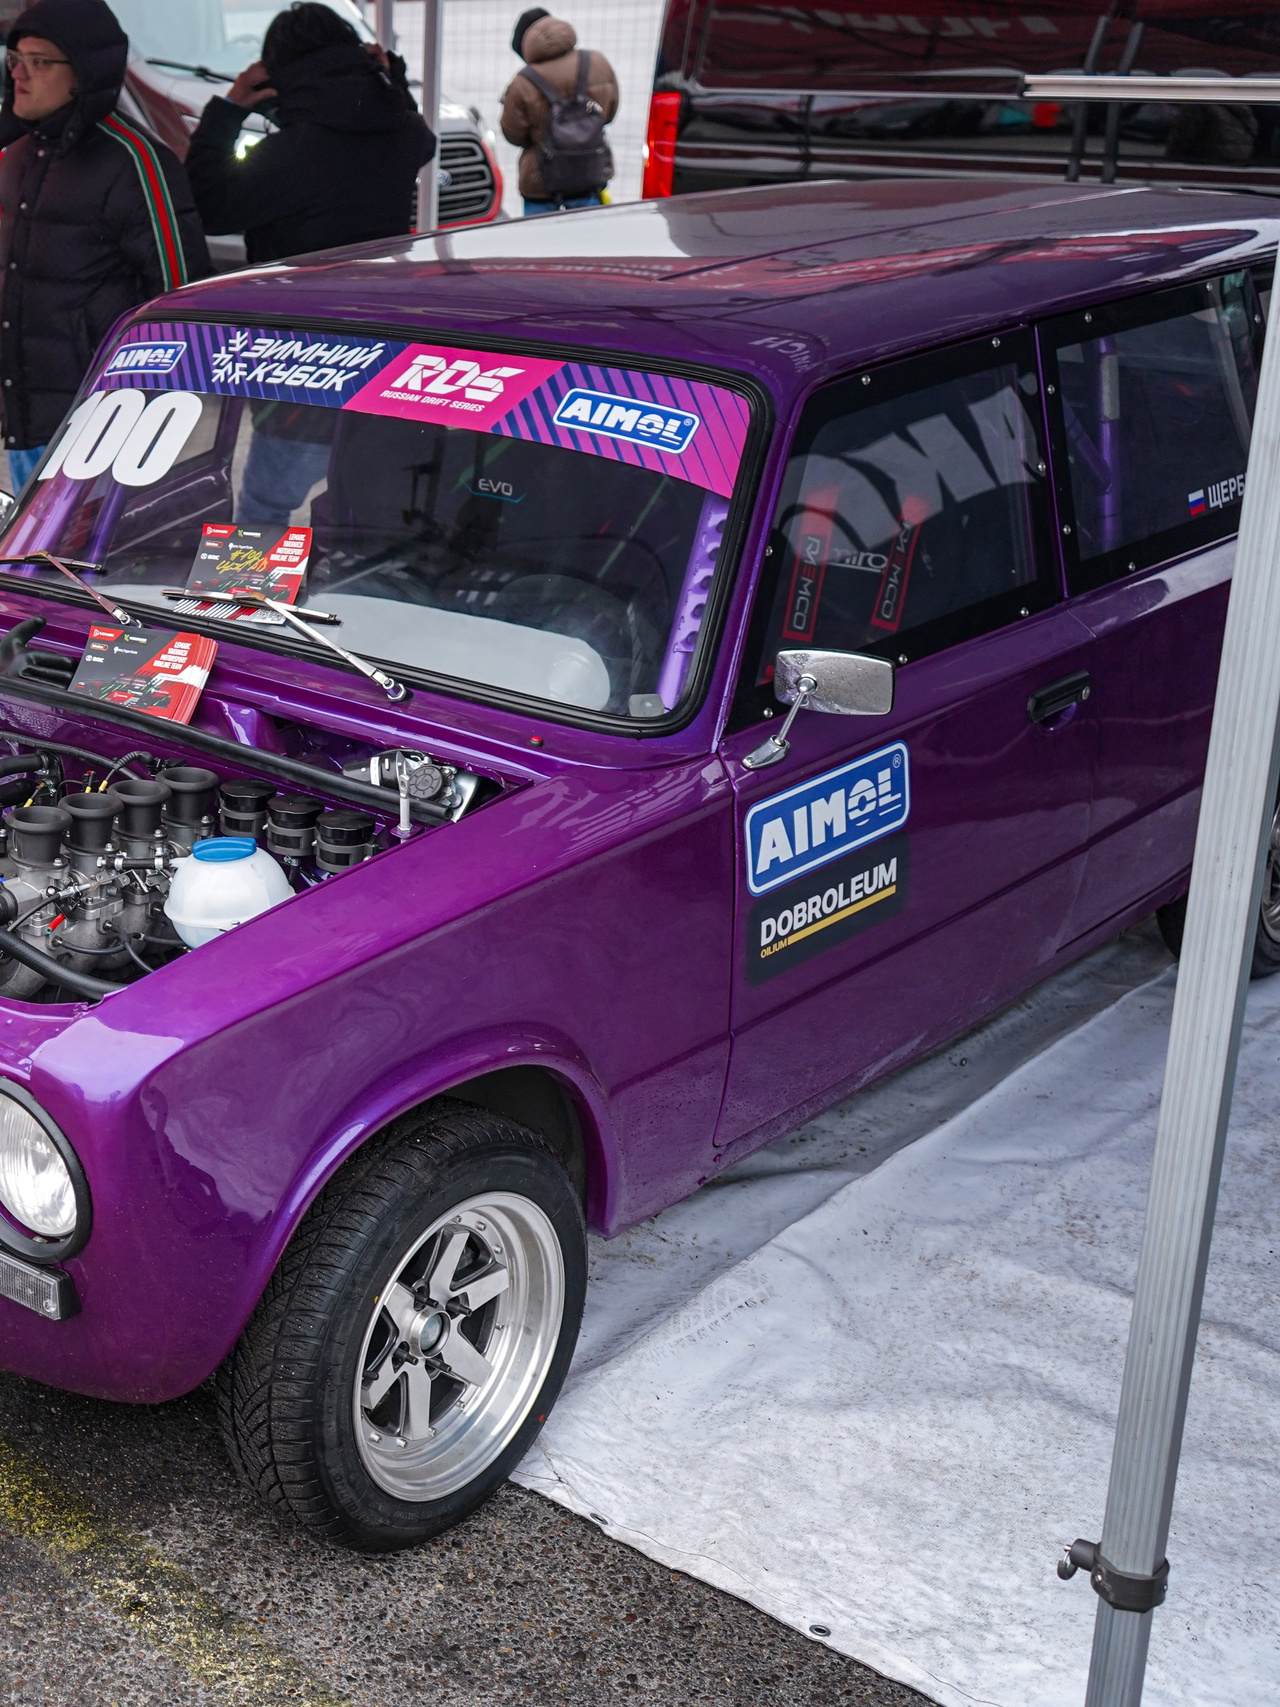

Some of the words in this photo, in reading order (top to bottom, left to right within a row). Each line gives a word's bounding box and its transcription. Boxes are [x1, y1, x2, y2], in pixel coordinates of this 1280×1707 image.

[109, 349, 179, 367] AIMOL
[241, 338, 386, 369] ЗИМНИЙ
[246, 363, 360, 391] КУБОК
[390, 354, 525, 402] RDS
[379, 389, 422, 404] RUSSIAN
[420, 395, 450, 408] DRIFT
[449, 400, 485, 413] SERIES
[37, 388, 203, 486] 100
[560, 398, 682, 445] AIMOL
[478, 479, 513, 496] EVO
[1208, 472, 1247, 509] ЩЕРБ
[756, 768, 902, 875] AIMOL
[760, 857, 897, 946] DOBROLEUM
[760, 938, 788, 959] OILIUM
